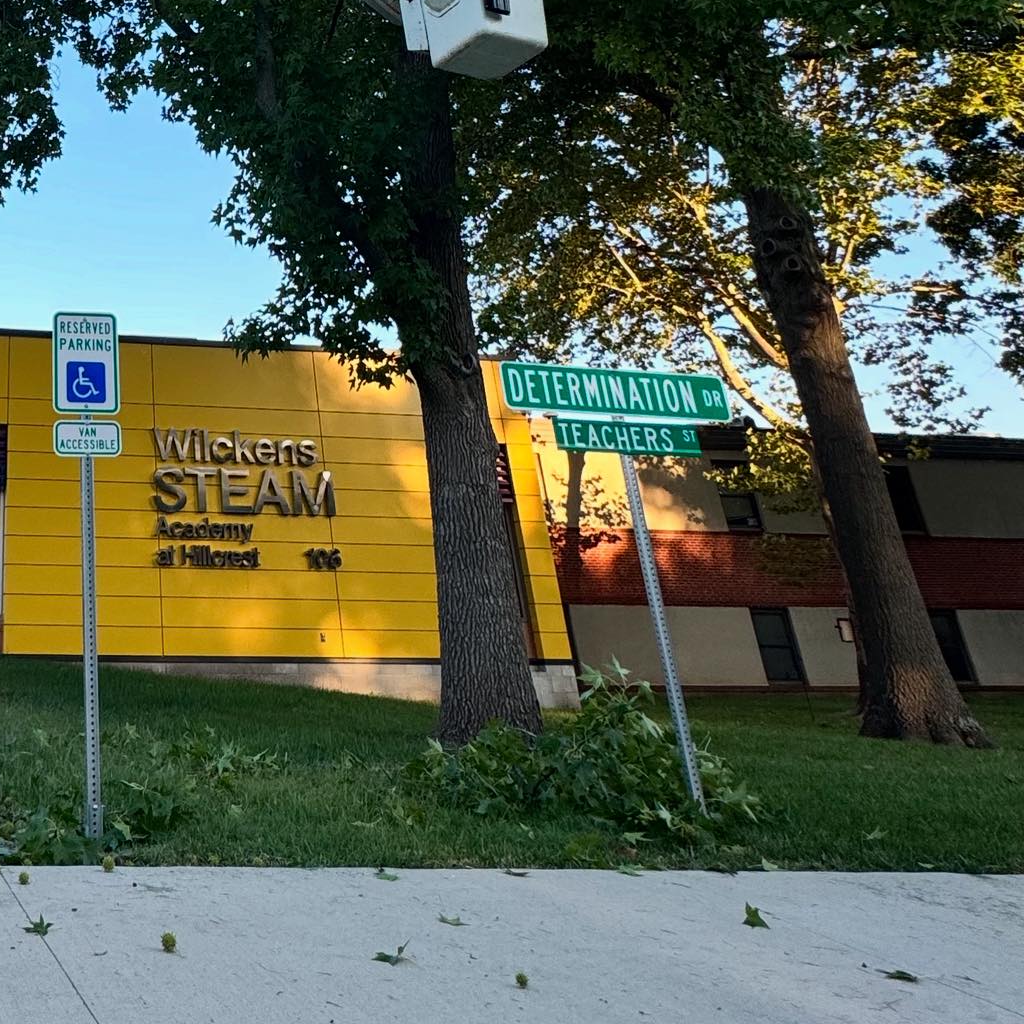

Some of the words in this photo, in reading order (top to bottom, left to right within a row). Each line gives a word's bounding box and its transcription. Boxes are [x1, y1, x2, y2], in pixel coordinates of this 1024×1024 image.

[60, 321, 111, 335] RESERVED
[59, 338, 112, 352] PARKING
[507, 368, 698, 414] DETERMINATION
[702, 390, 724, 408] DR
[59, 439, 116, 450] ACCESSIBLE
[79, 427, 97, 437] VAN
[559, 423, 674, 452] TEACHERS
[682, 429, 696, 443] ST
[153, 427, 319, 466] Wilckens
[152, 467, 336, 517] STEAM
[155, 515, 253, 544] Academy
[156, 546, 175, 567] at
[181, 545, 260, 568] Hillcrest
